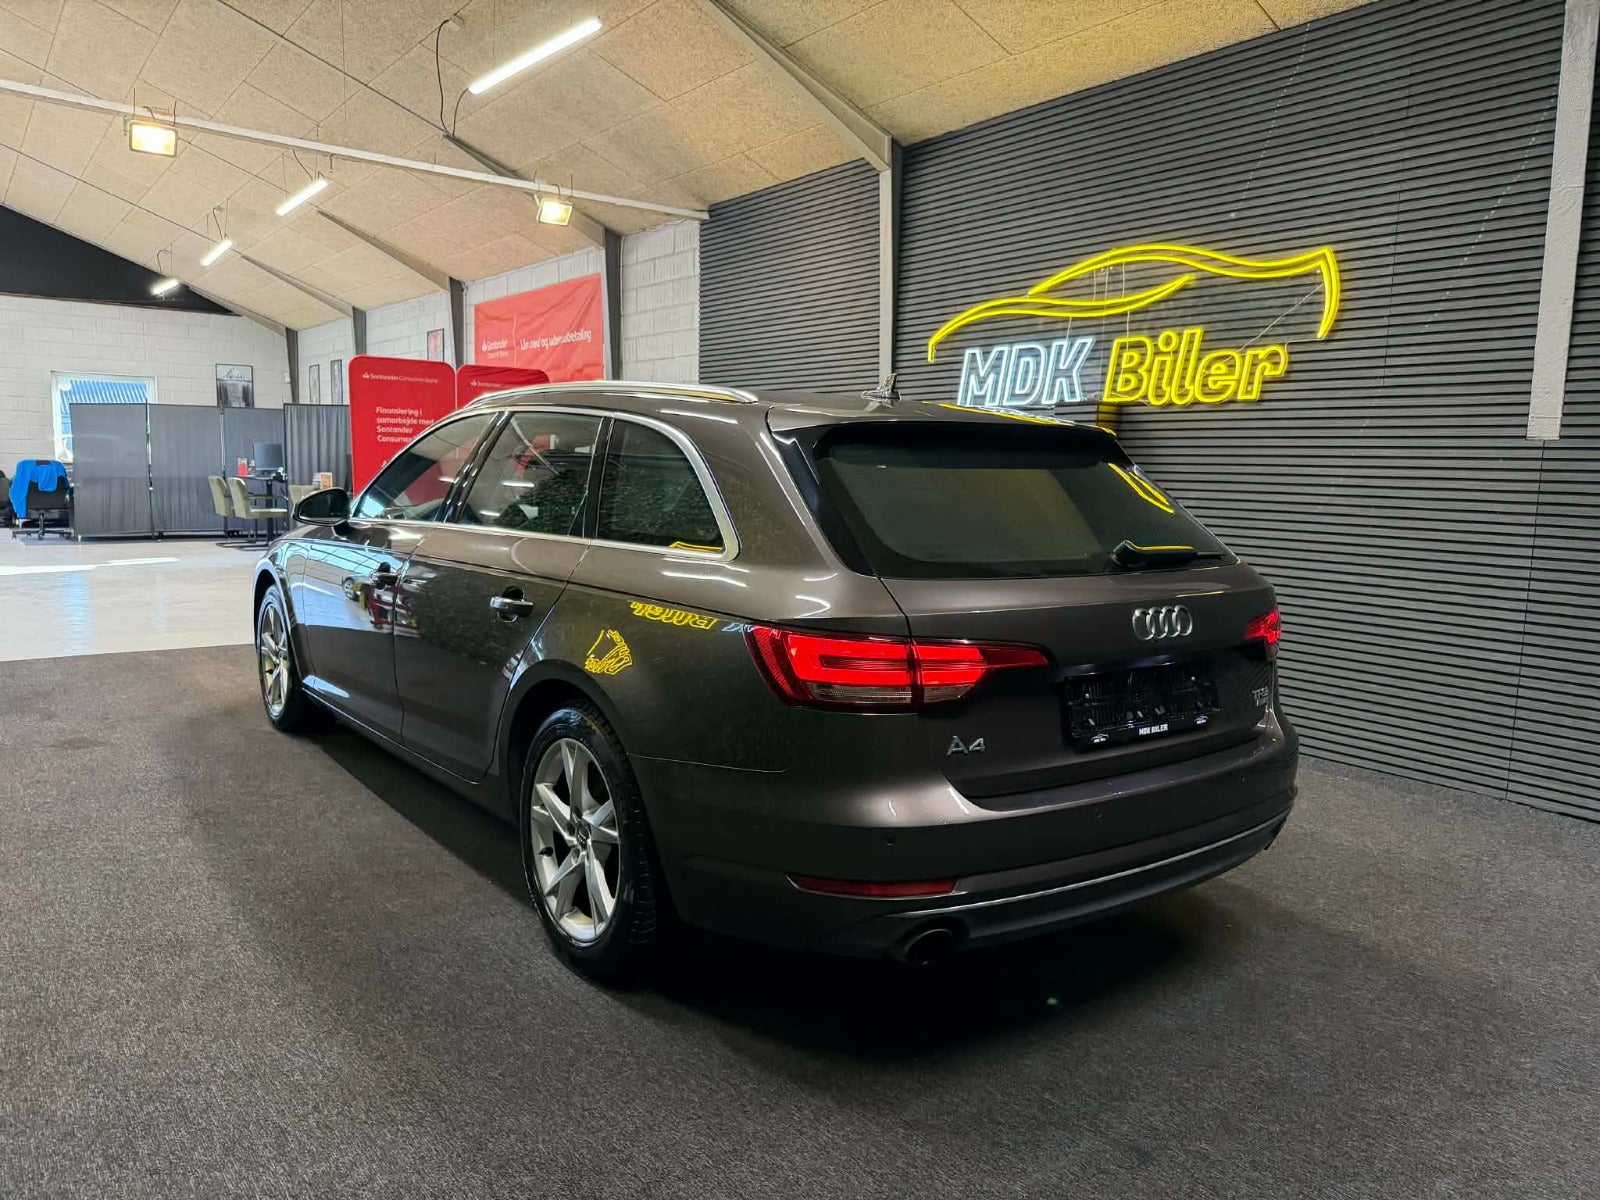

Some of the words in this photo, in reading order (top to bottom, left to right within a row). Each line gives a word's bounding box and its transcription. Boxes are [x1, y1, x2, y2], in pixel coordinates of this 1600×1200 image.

[957, 337, 1095, 406] MDK
[1103, 328, 1289, 406] Biler
[375, 406, 419, 417] Finansiering
[376, 417, 418, 426] samarbejde
[376, 425, 413, 434] Santander
[946, 735, 986, 756] A4
